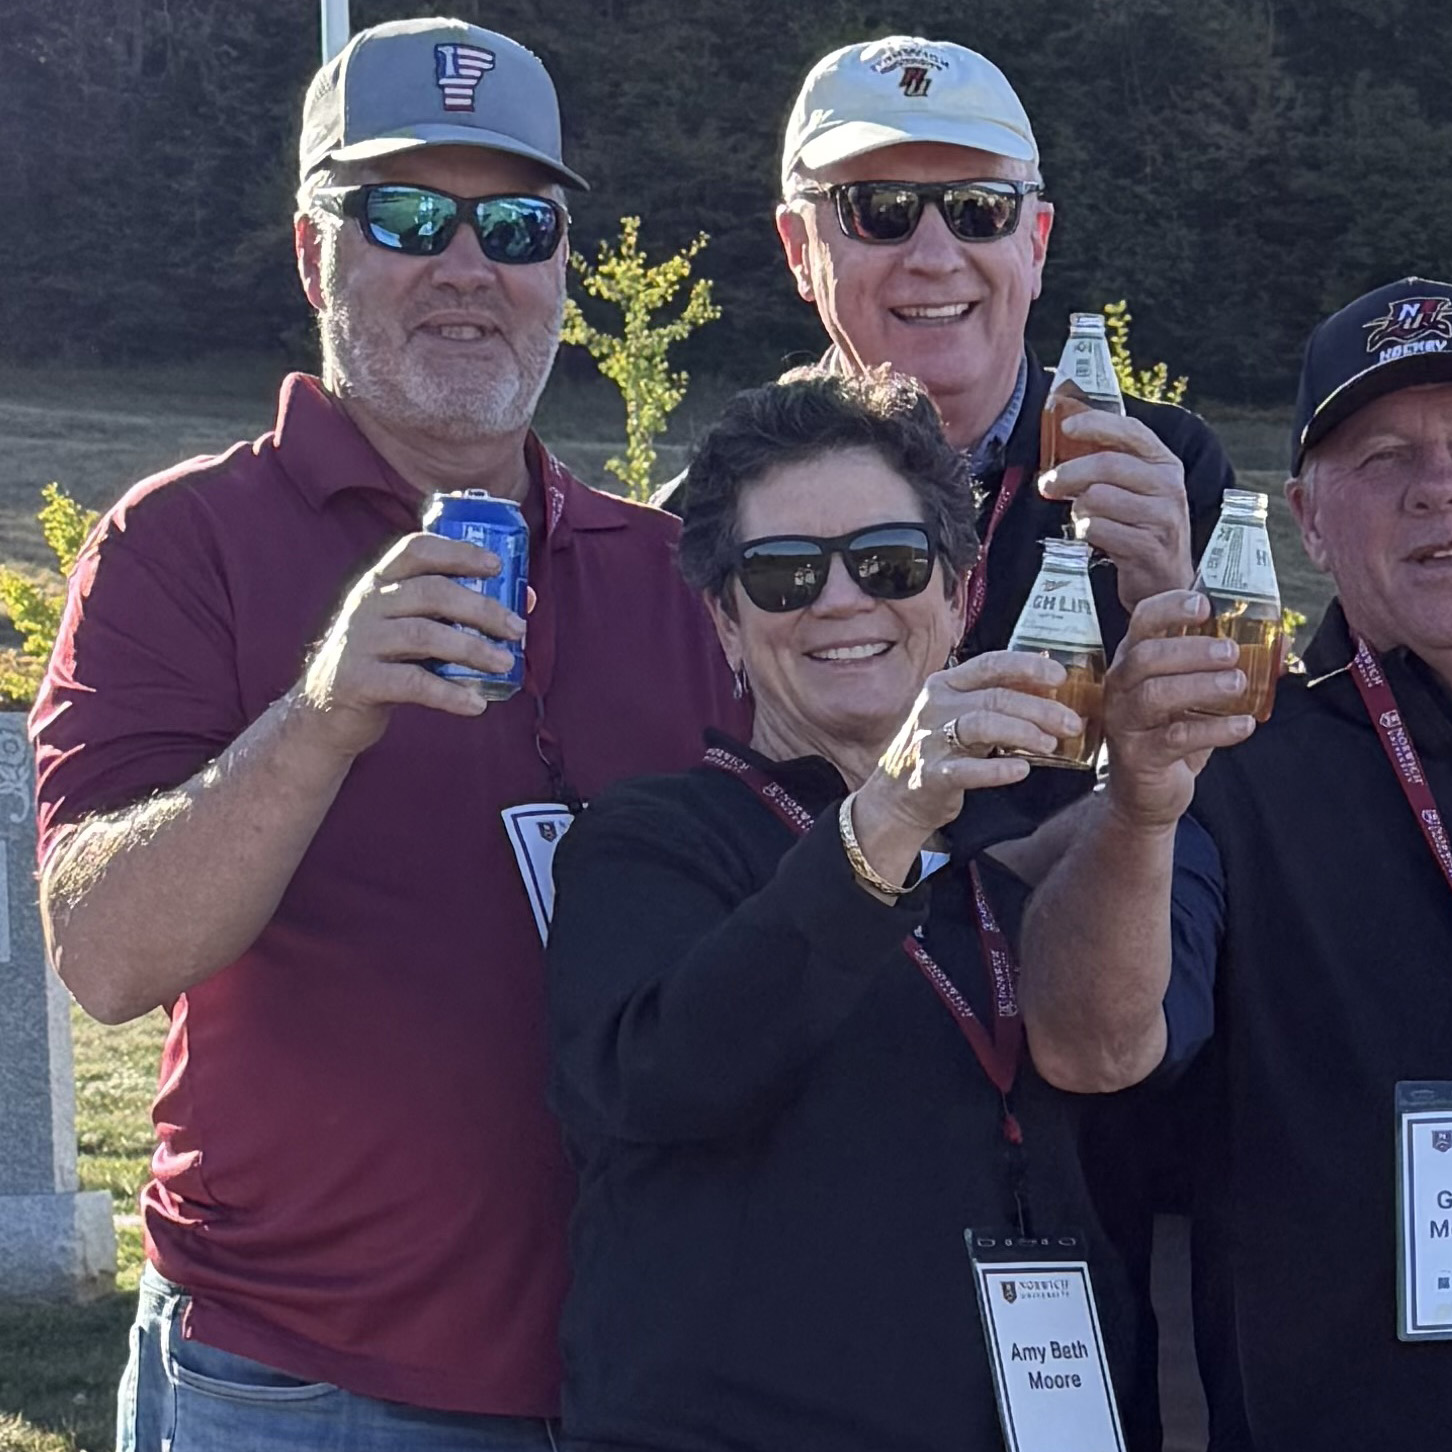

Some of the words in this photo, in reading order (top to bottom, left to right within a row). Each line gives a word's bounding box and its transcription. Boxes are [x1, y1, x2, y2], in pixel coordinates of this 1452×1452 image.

[1380, 340, 1448, 364] HOCKEY
[1033, 594, 1057, 611] GH
[1011, 1342, 1047, 1364] Amy
[1050, 1340, 1089, 1359] Beth
[1027, 1371, 1082, 1390] Moore
